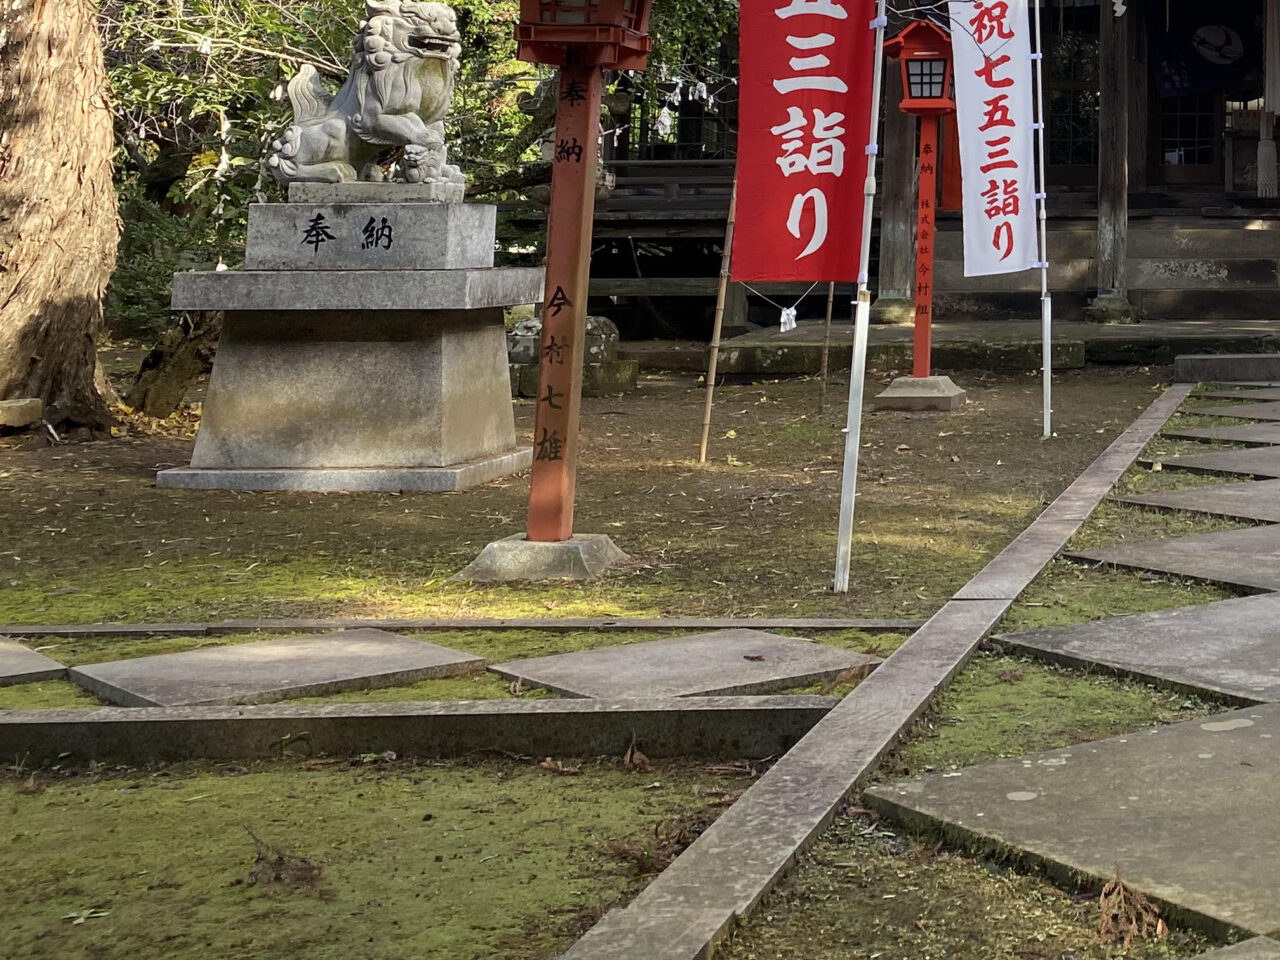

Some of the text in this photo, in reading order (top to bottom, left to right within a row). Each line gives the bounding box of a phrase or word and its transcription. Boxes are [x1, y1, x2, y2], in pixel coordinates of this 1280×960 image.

[555, 78, 586, 163] 奉納
[968, 1, 1020, 261] 祝七五三詣り
[301, 212, 393, 254] 奉納
